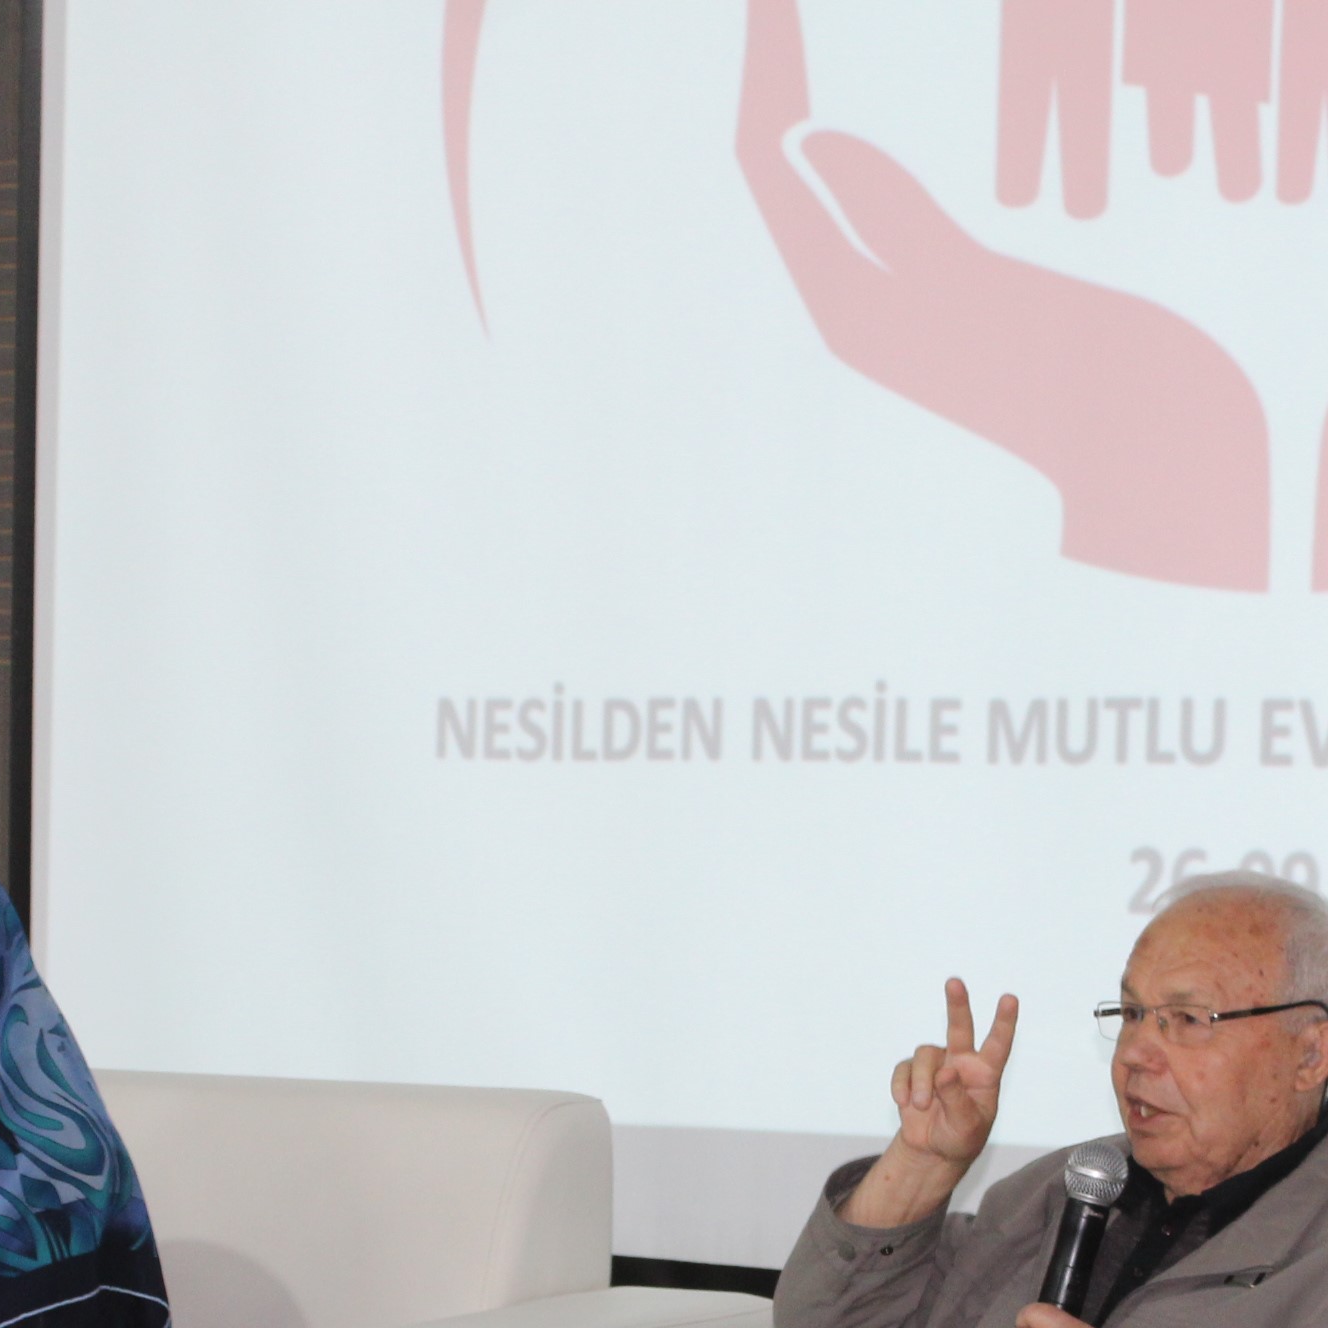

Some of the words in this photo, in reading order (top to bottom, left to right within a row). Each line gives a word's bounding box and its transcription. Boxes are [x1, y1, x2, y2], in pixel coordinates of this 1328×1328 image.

[435, 682, 724, 763] NESİLDEN
[751, 680, 962, 764] NESİLE
[986, 696, 1227, 767] MUTLU
